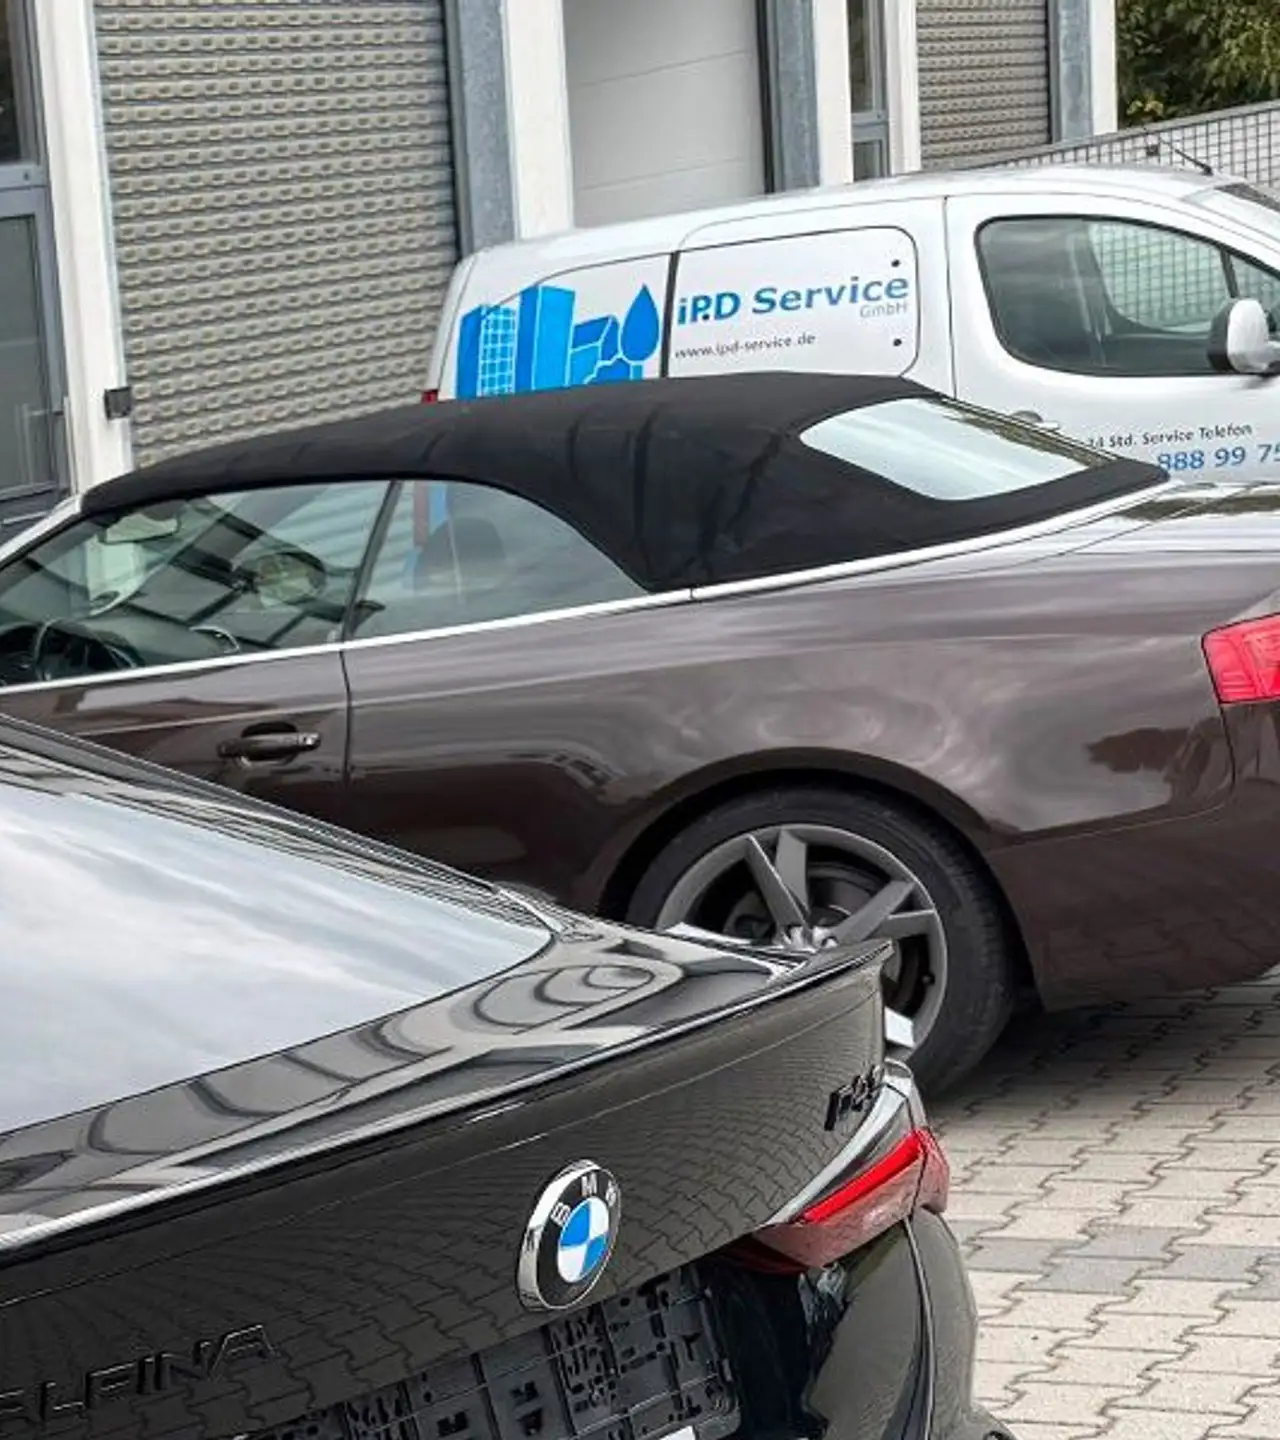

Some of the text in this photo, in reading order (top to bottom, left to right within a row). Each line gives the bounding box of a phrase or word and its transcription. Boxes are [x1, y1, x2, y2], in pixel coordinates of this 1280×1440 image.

[751, 276, 909, 315] Service
[860, 300, 908, 319] GmbH
[1143, 429, 1194, 447] Service
[1198, 422, 1253, 441] Telefon
[1214, 445, 1247, 468] 99
